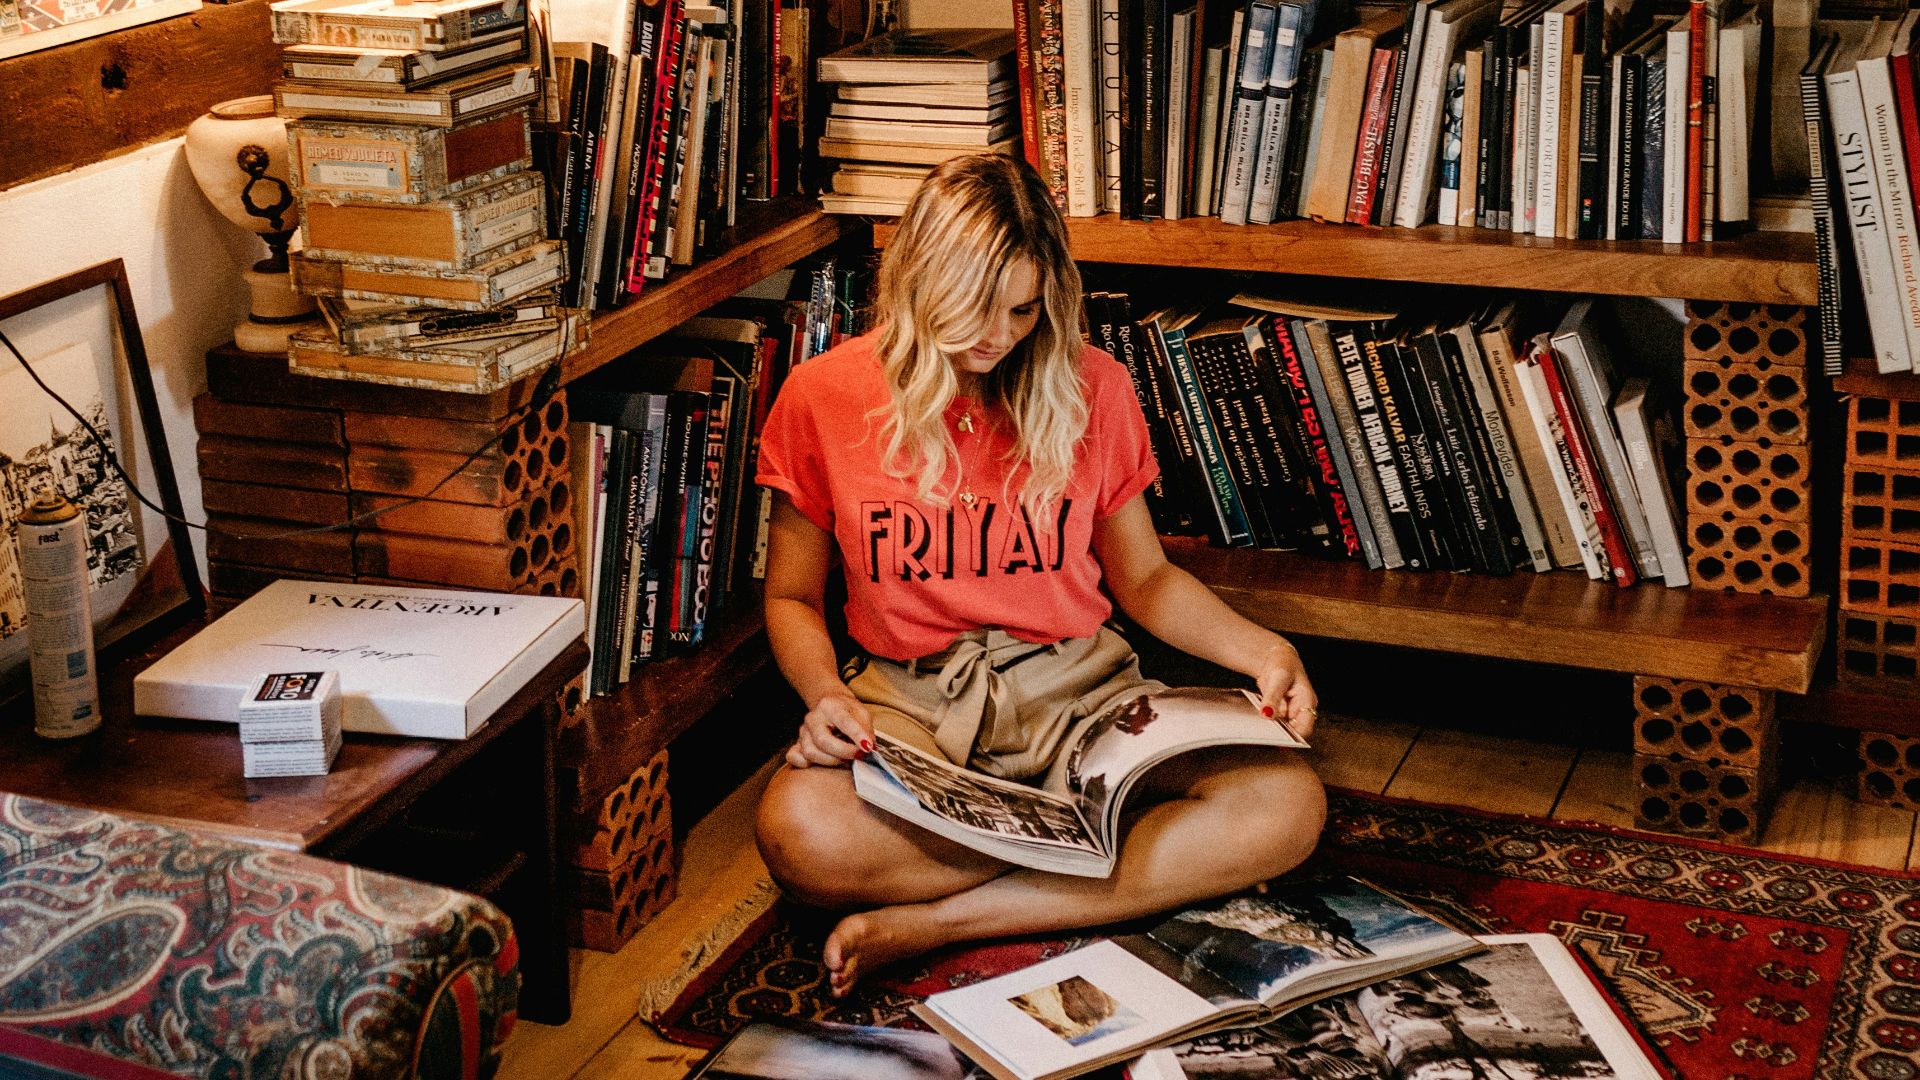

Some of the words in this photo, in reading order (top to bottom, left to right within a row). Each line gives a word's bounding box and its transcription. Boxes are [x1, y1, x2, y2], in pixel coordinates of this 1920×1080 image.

[1016, 3, 1027, 43] HAVANA
[1018, 45, 1029, 68] VIEJA
[1547, 20, 1557, 77] RICHARD
[1024, 86, 1033, 115] Claudio
[1144, 69, 1152, 97] História
[1625, 68, 1634, 100] ANTIGAS
[1070, 87, 1082, 126] Images
[1410, 99, 1424, 147] PAISAGEM
[1545, 83, 1555, 133] AVEDON
[1623, 102, 1632, 139] FAZENDAS
[1239, 104, 1251, 152] BRASÍLIA
[1268, 103, 1281, 151] BRASÍLIA
[1874, 103, 1892, 150] Woman
[583, 130, 594, 170] ARENA
[1072, 135, 1083, 157] Rock
[1381, 145, 1391, 174] CATARINA
[1622, 153, 1630, 166] RIO
[1623, 140, 1631, 152] DO
[1882, 152, 1896, 166] in
[1074, 176, 1084, 195] Roll
[1234, 155, 1244, 187] PLENA
[1263, 154, 1273, 186] PLENA
[1400, 152, 1414, 206] BRASILEIRA
[1542, 138, 1553, 207] PORTRAITS
[1621, 167, 1630, 200] GRANDE
[1837, 130, 1879, 234] STYLIST
[1885, 168, 1900, 189] the
[1620, 200, 1628, 212] DO
[1620, 213, 1628, 227] SUL
[1889, 189, 1906, 231] Mirror
[1897, 234, 1915, 282] Richard
[1906, 284, 1920, 328] Avedon
[1099, 323, 1113, 341] Rio
[1118, 324, 1132, 343] Rio
[1336, 333, 1360, 365] PETE
[1122, 341, 1140, 376] Grande
[1491, 349, 1502, 365] Bob
[1345, 361, 1374, 410] TURNER
[1496, 365, 1517, 407] Wolfenson
[1175, 353, 1192, 384] HENRI
[1184, 383, 1205, 425] CARTIER
[1197, 423, 1218, 465] BRESSON
[1214, 396, 1232, 428] Brasil
[1232, 397, 1250, 429] Brasil
[1253, 393, 1272, 425] Brasil
[1442, 416, 1451, 426] de
[1225, 428, 1238, 443] do
[1243, 429, 1255, 445] do
[1265, 425, 1277, 440] do
[1316, 341, 1335, 376] ANNIE
[1327, 374, 1352, 428] LEIBOVITZ
[1343, 425, 1366, 468] WOMEN
[1357, 467, 1378, 505] SUSAN
[1369, 505, 1392, 548] SONTAG
[1360, 410, 1391, 464] AFRICAN
[1362, 339, 1391, 395] RICHARD
[1380, 394, 1407, 444] KALVAR
[1397, 443, 1432, 520] EARTHLINGS
[1445, 427, 1462, 451] Luiz
[1482, 408, 1519, 479] Montevideo
[677, 415, 693, 494] BOURKE-WHITE
[1230, 442, 1255, 486] Coração
[1248, 444, 1272, 487] Coração
[1270, 439, 1294, 483] Coração
[1453, 449, 1473, 484] Carlos
[638, 446, 651, 505] AMAZÔNIA
[1375, 460, 1408, 517] JOURNEY
[624, 474, 639, 533] GRAMADO
[1464, 483, 1489, 532] Felizardo
[308, 593, 515, 617] ARGENTINA
[279, 674, 307, 699] FOTO
